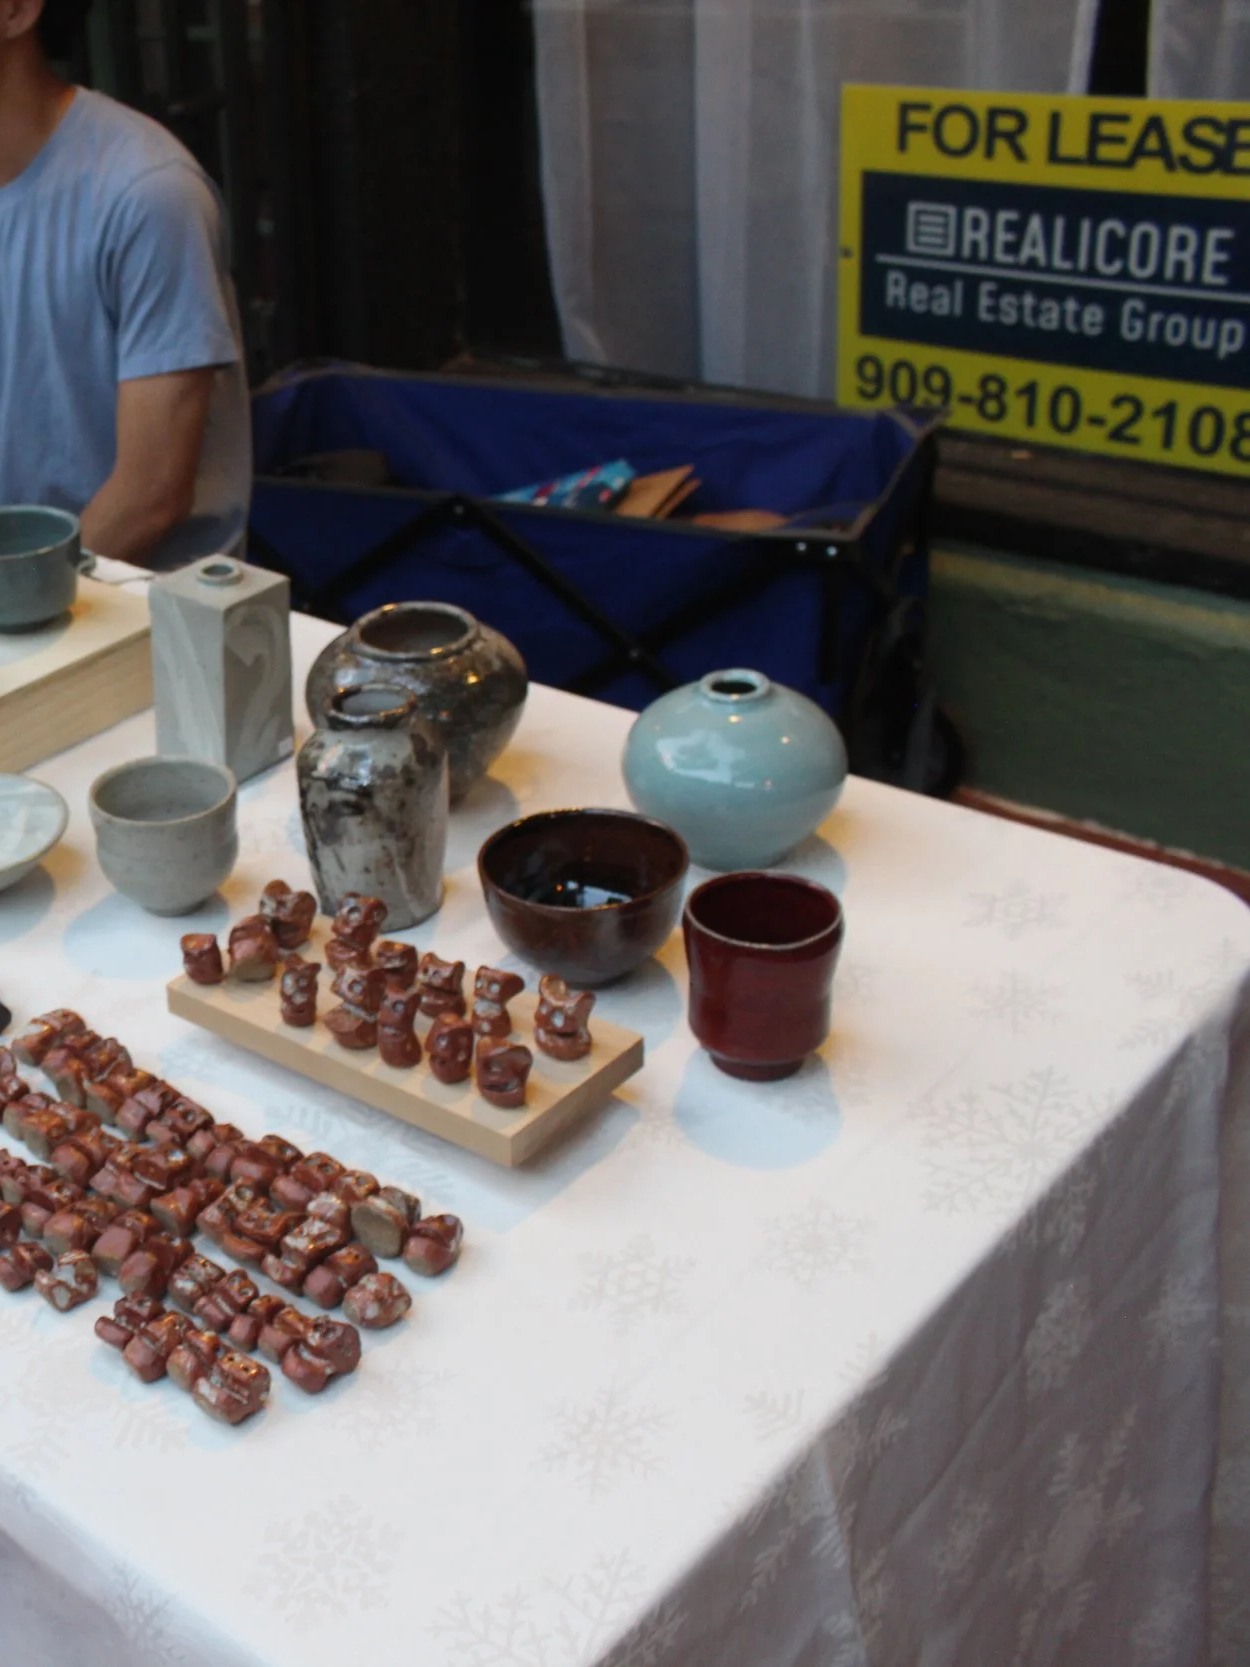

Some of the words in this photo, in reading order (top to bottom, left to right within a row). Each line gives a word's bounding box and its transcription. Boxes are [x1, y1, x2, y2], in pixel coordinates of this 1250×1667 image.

[897, 101, 1029, 164] FOR
[1046, 110, 1250, 176] LEASE
[961, 205, 1235, 286] REALICORE
[886, 269, 964, 317] Real
[977, 281, 1105, 337] Estate
[1120, 298, 1246, 361] Group
